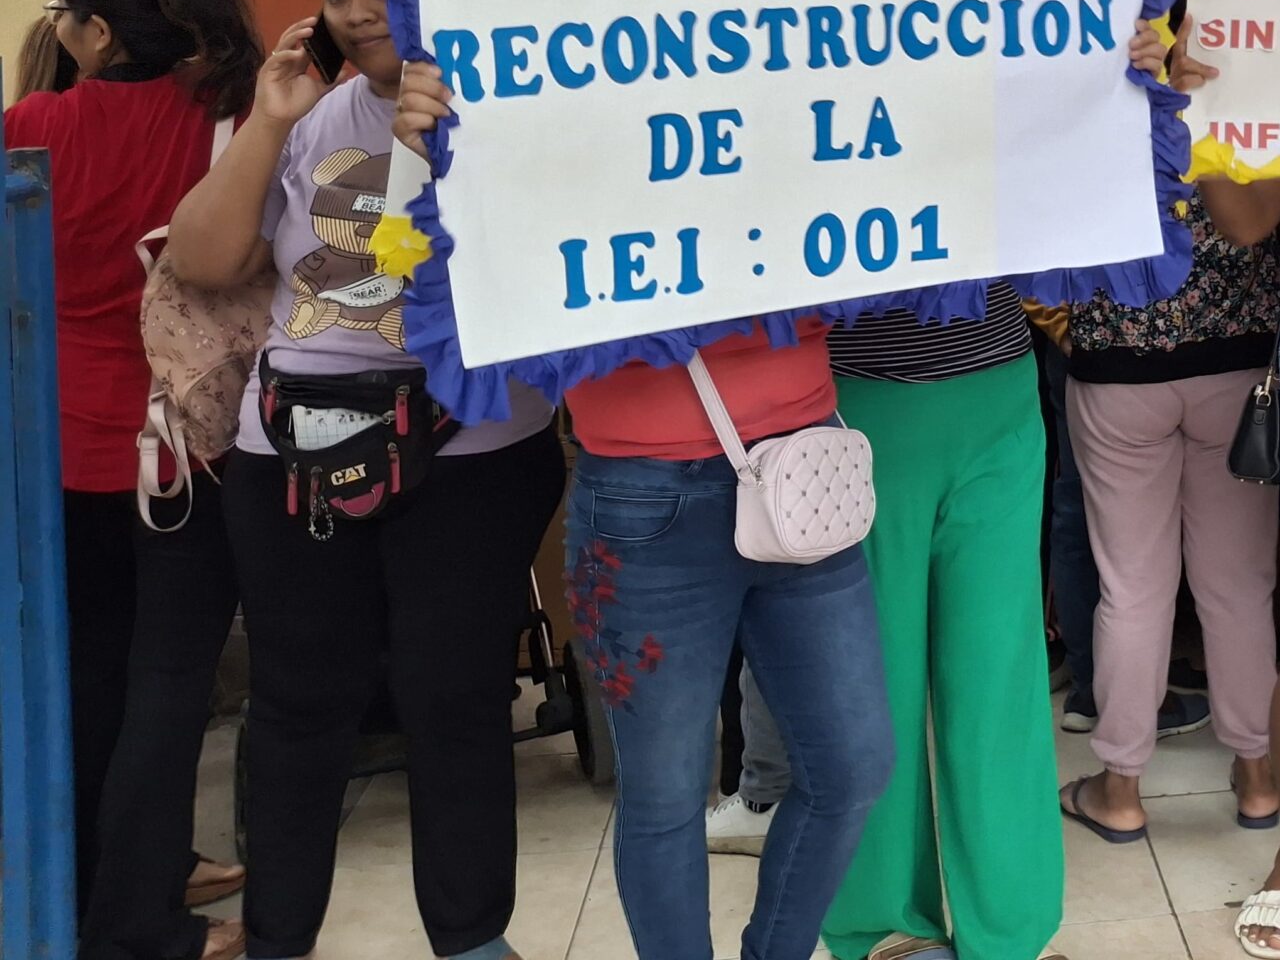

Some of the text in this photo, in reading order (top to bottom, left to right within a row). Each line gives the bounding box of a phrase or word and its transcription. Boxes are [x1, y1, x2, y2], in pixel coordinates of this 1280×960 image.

[1200, 19, 1275, 49] SIN
[647, 96, 902, 182] DE LA
[361, 203, 386, 212] BEA
[558, 227, 704, 310] I.E.I
[803, 205, 949, 278] 001
[330, 463, 367, 486] CAT
